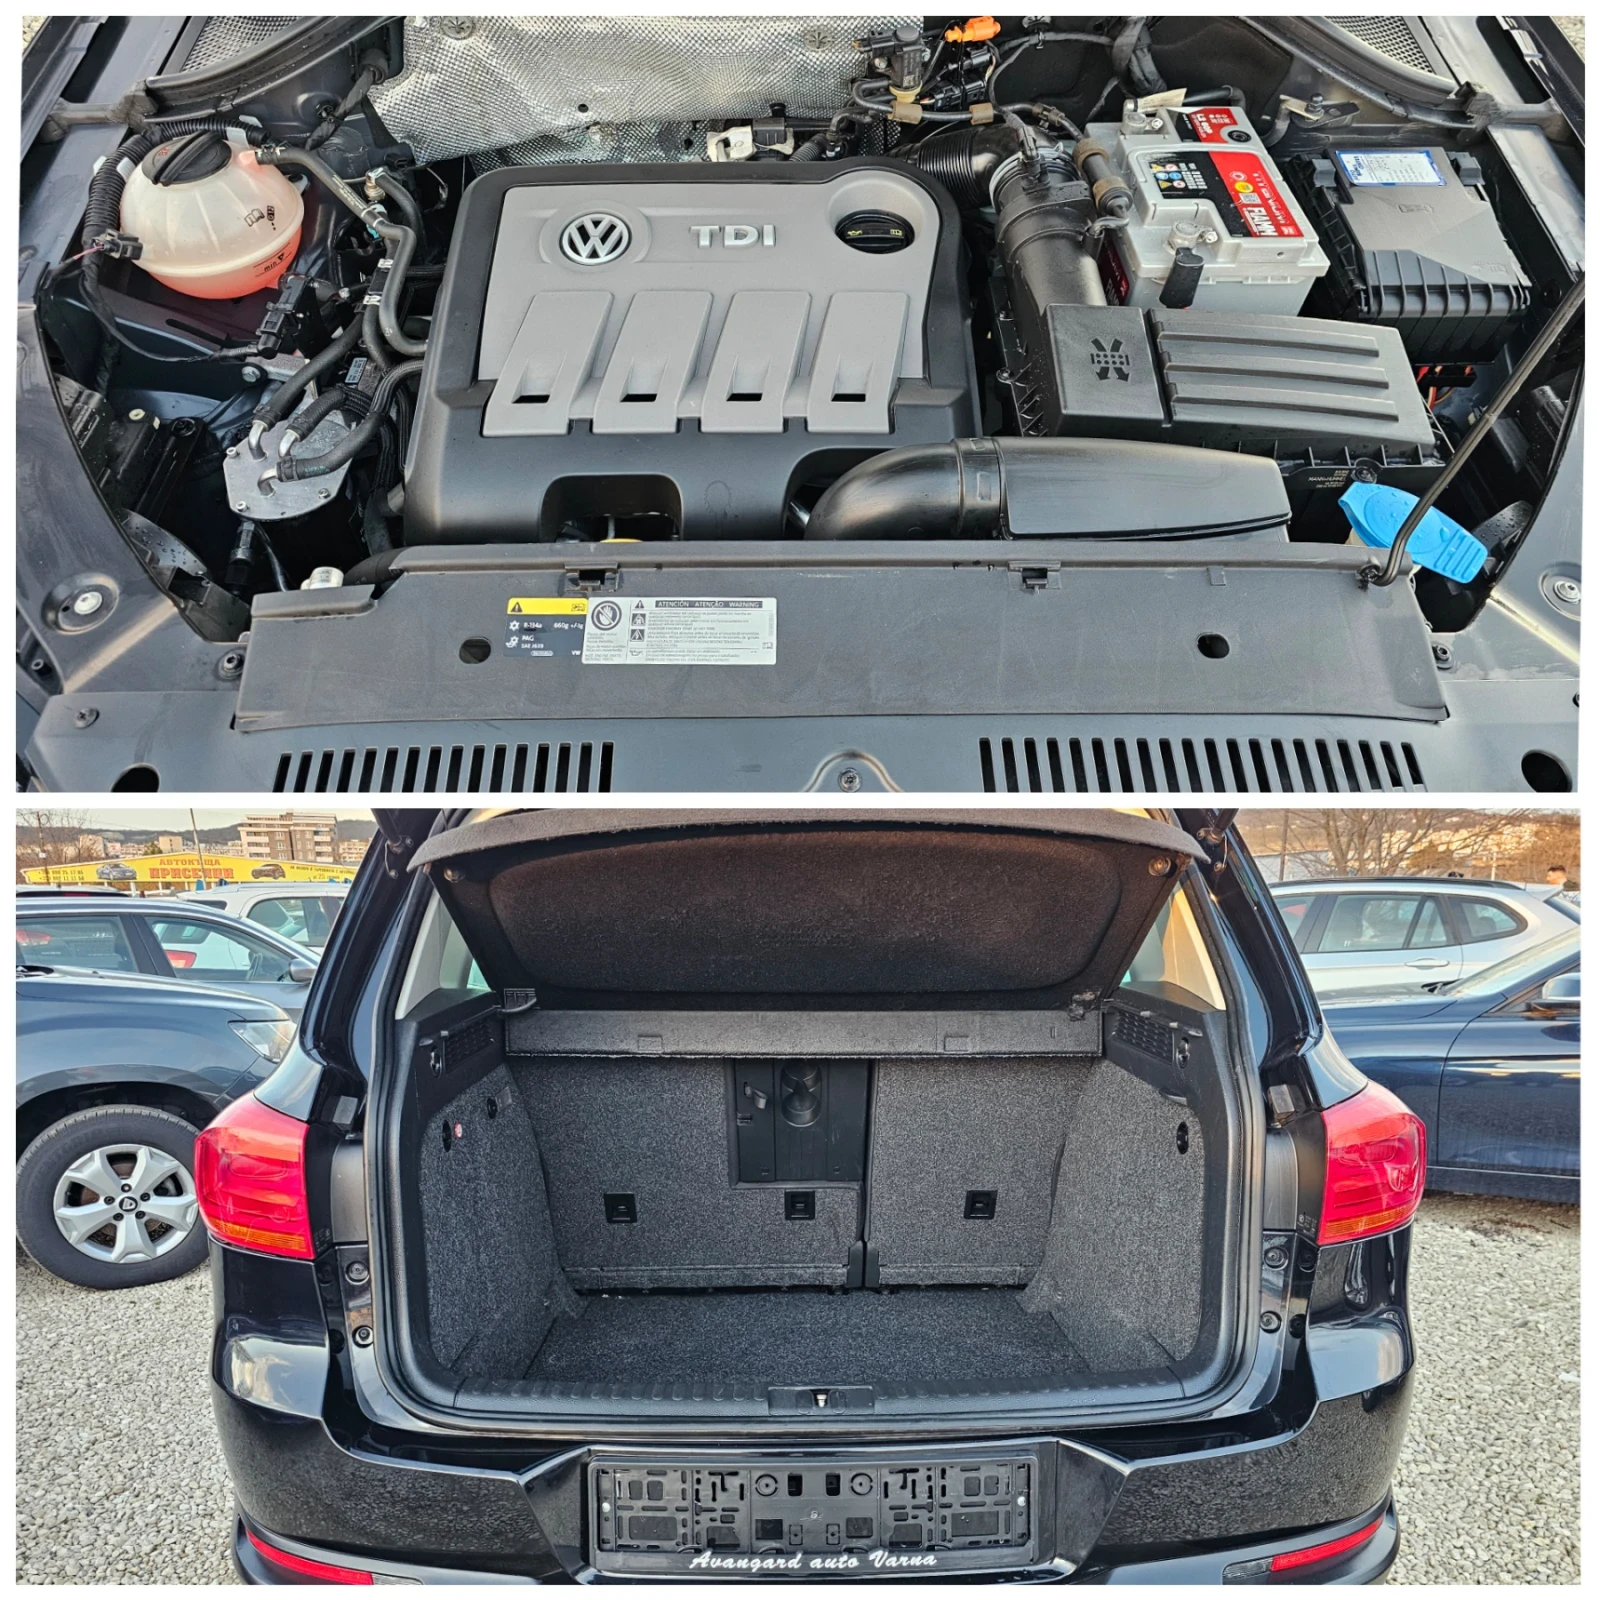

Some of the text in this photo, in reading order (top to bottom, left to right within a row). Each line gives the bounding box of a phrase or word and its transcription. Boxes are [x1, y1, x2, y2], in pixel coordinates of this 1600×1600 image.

[1246, 207, 1279, 236] FIAMM
[689, 225, 777, 248] TDI
[264, 262, 277, 272] min
[694, 600, 724, 608] ATENÇÃO
[689, 1551, 938, 1572] Avangard auto Varna
